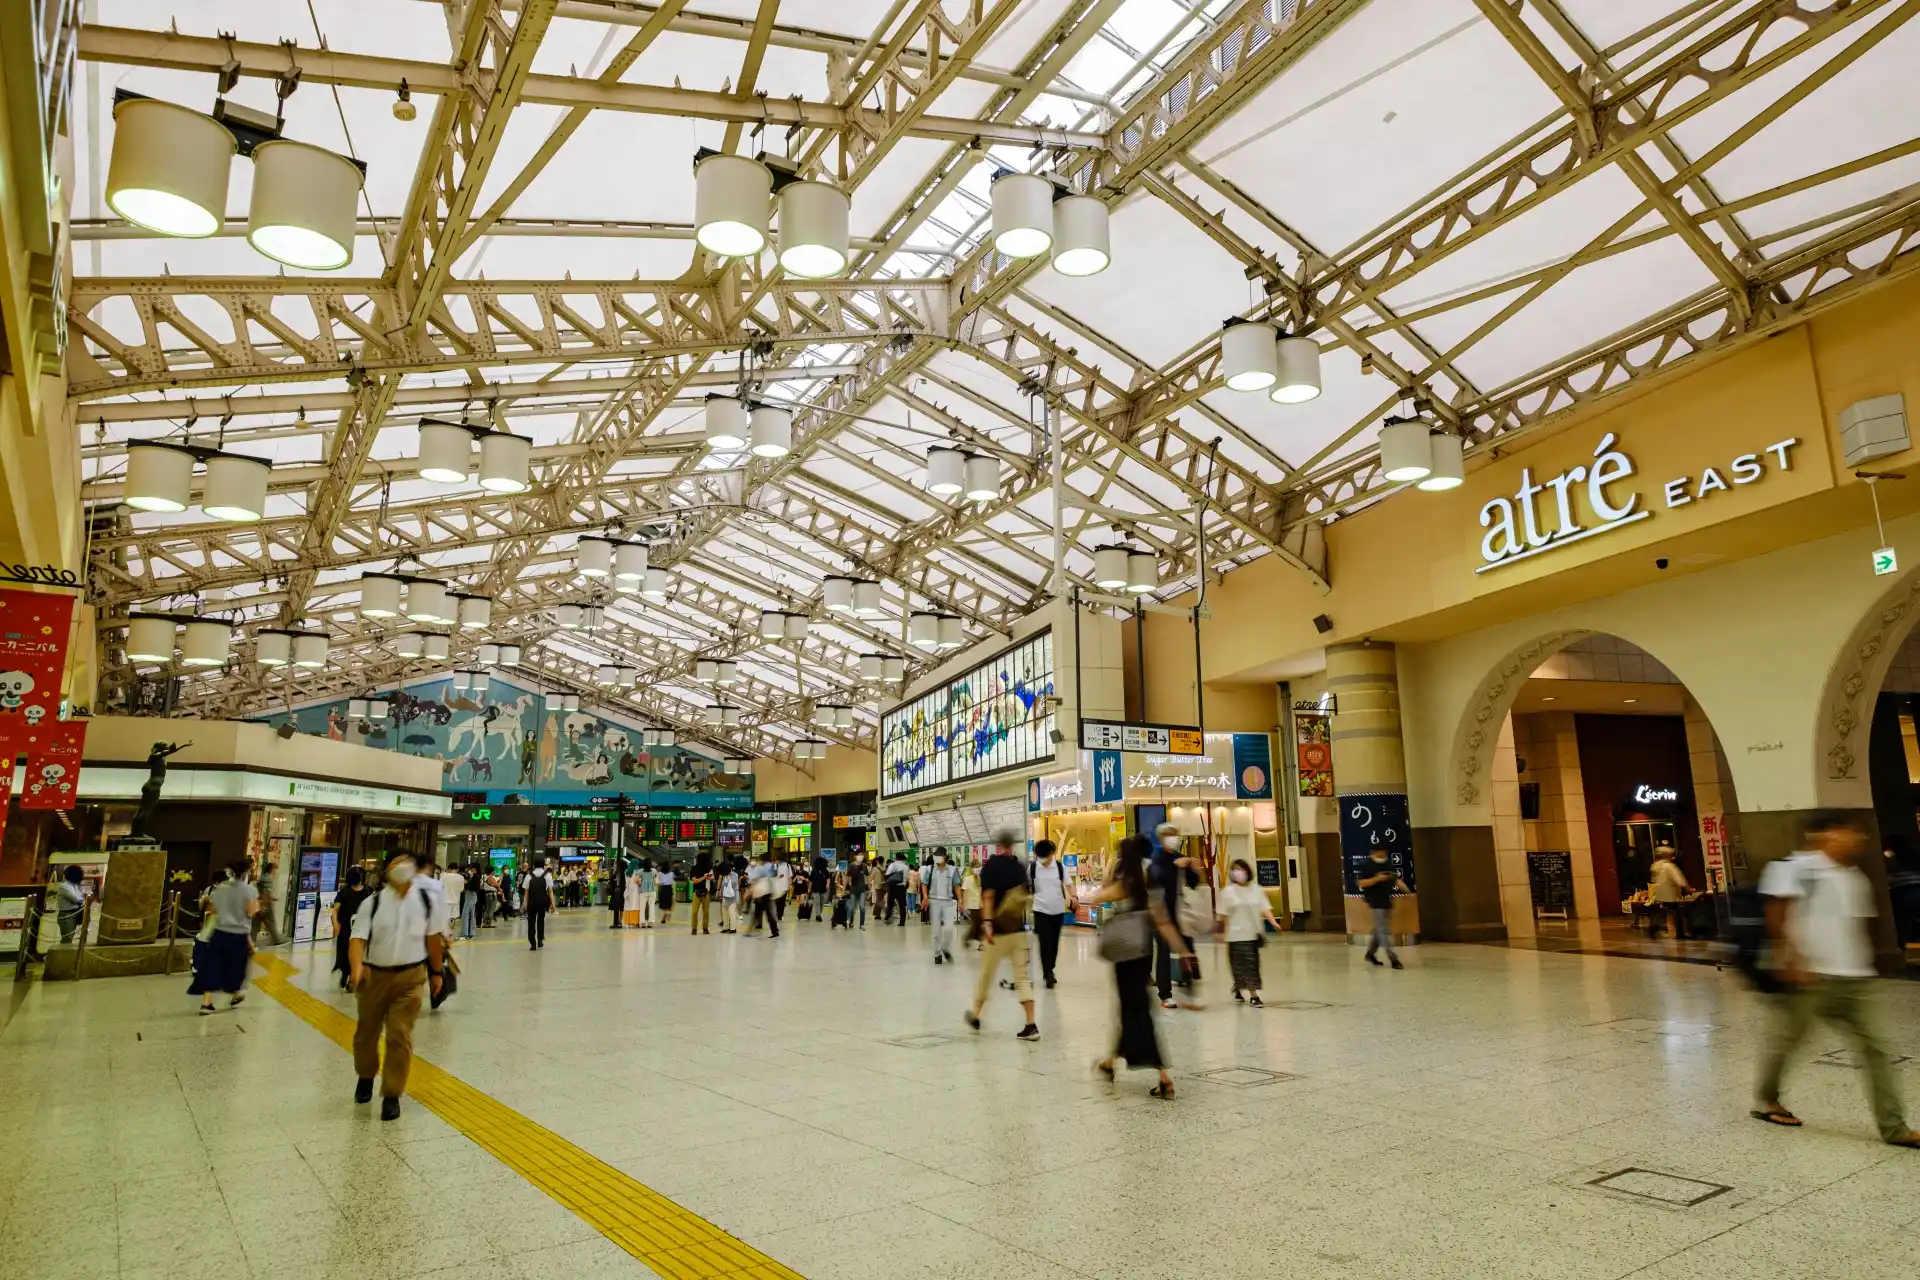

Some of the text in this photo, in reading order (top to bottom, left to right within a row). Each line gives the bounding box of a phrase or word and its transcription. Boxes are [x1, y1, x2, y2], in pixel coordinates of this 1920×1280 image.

[1479, 431, 1802, 562] atré EAST
[1145, 755, 1214, 767] Sugar Butter Tree
[1128, 770, 1232, 789] シュガーバターの木
[471, 809, 491, 821] JR
[557, 810, 581, 819] 上野駅
